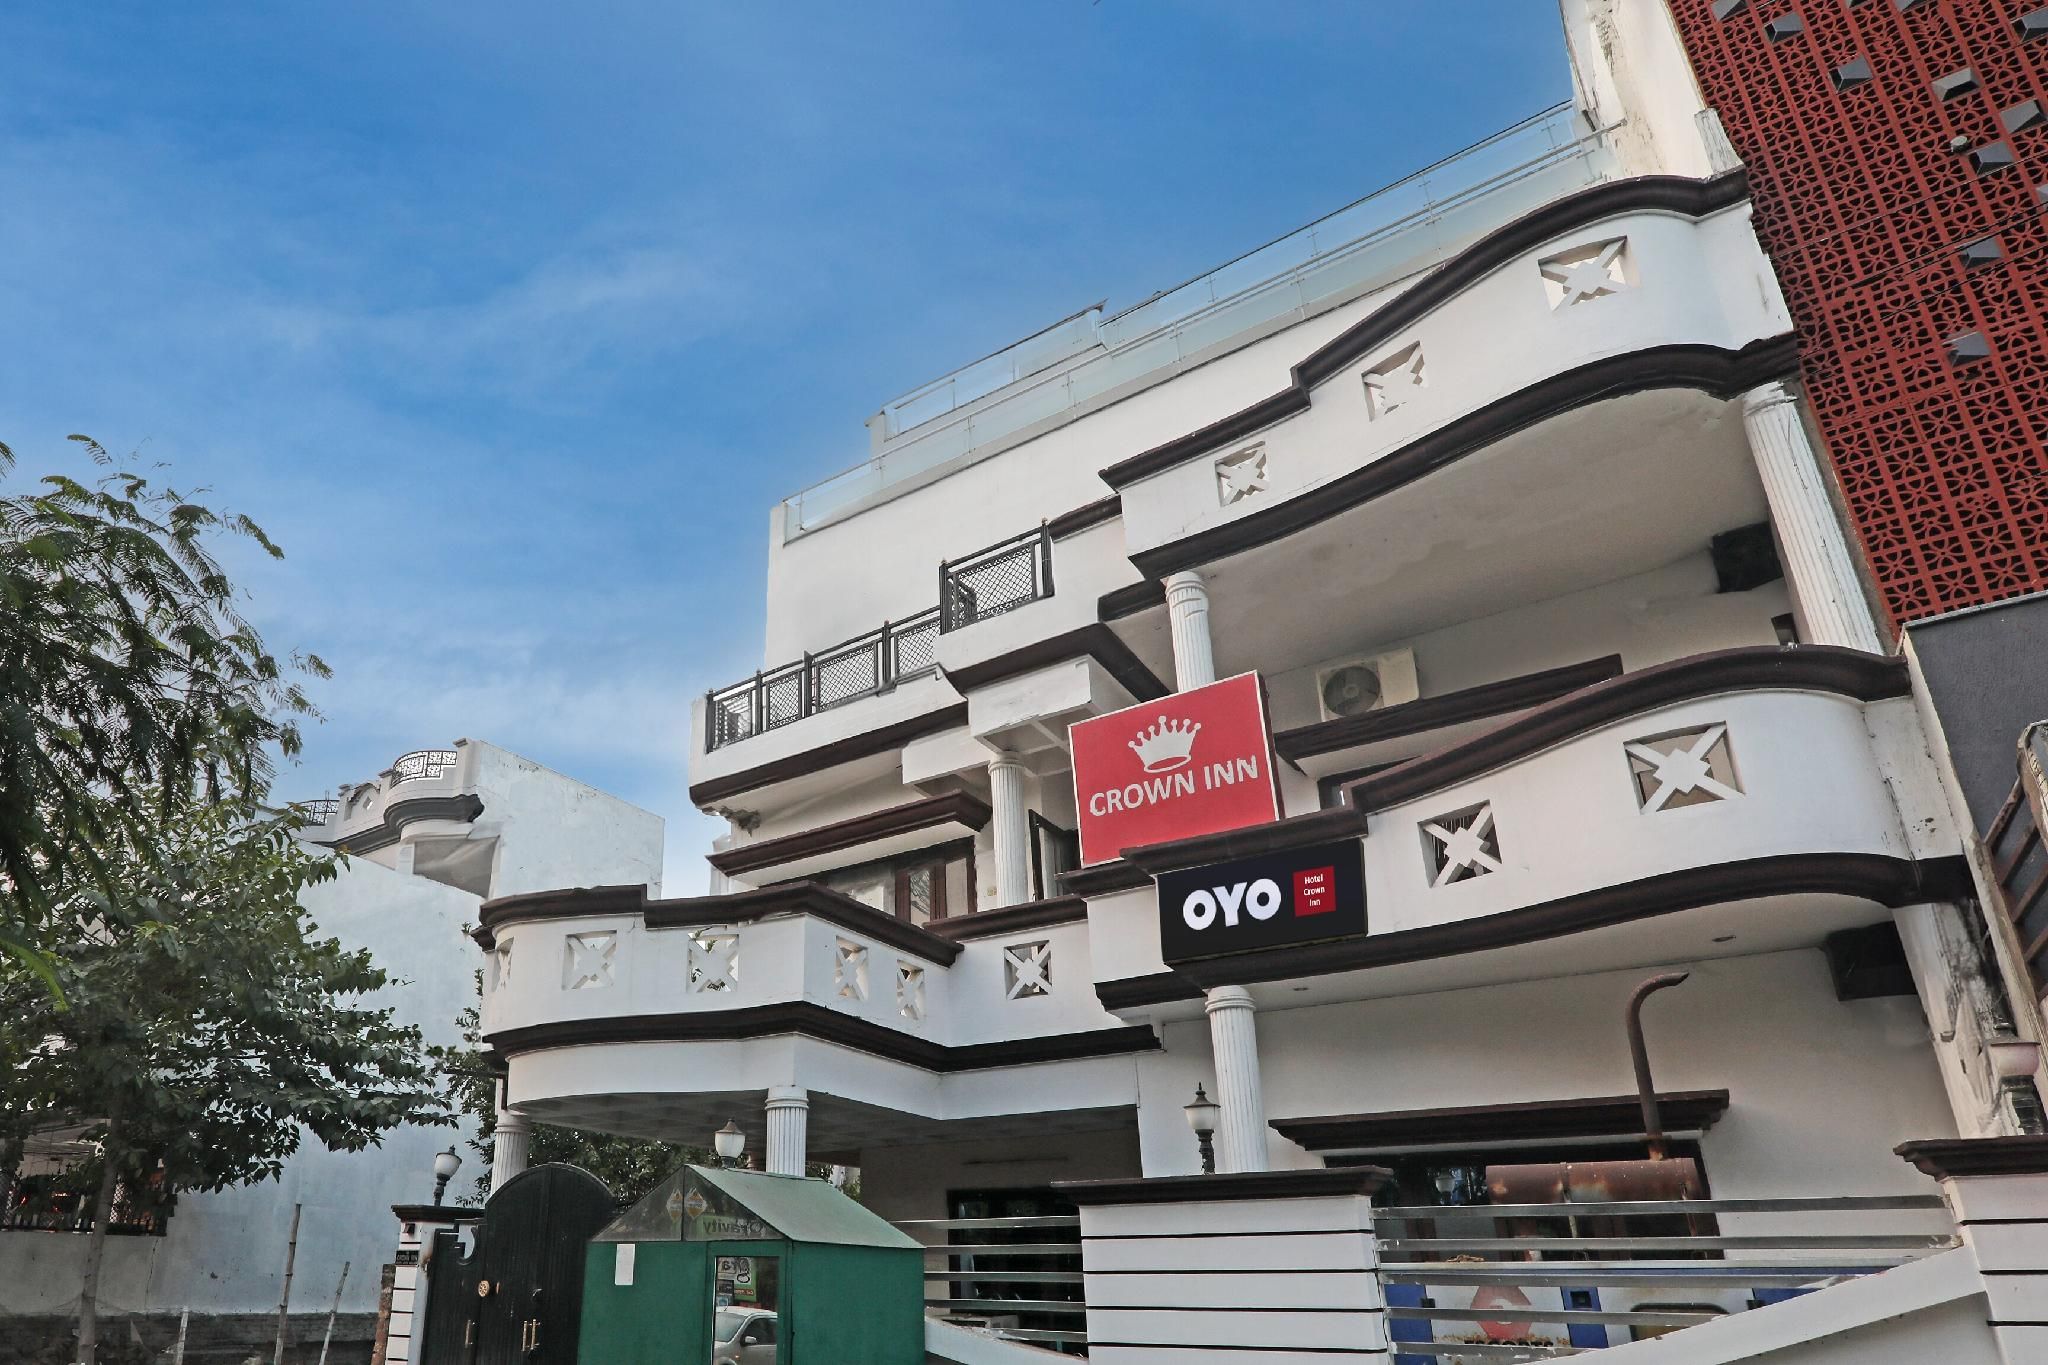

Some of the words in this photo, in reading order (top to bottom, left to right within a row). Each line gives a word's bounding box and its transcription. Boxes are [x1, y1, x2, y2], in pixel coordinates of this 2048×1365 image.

[1089, 770, 1195, 816] CROWN
[1203, 755, 1258, 790] INN
[1304, 873, 1324, 885] Hotel
[1303, 886, 1326, 896] Crown
[1182, 878, 1282, 931] OYO
[1309, 899, 1321, 907] Inn
